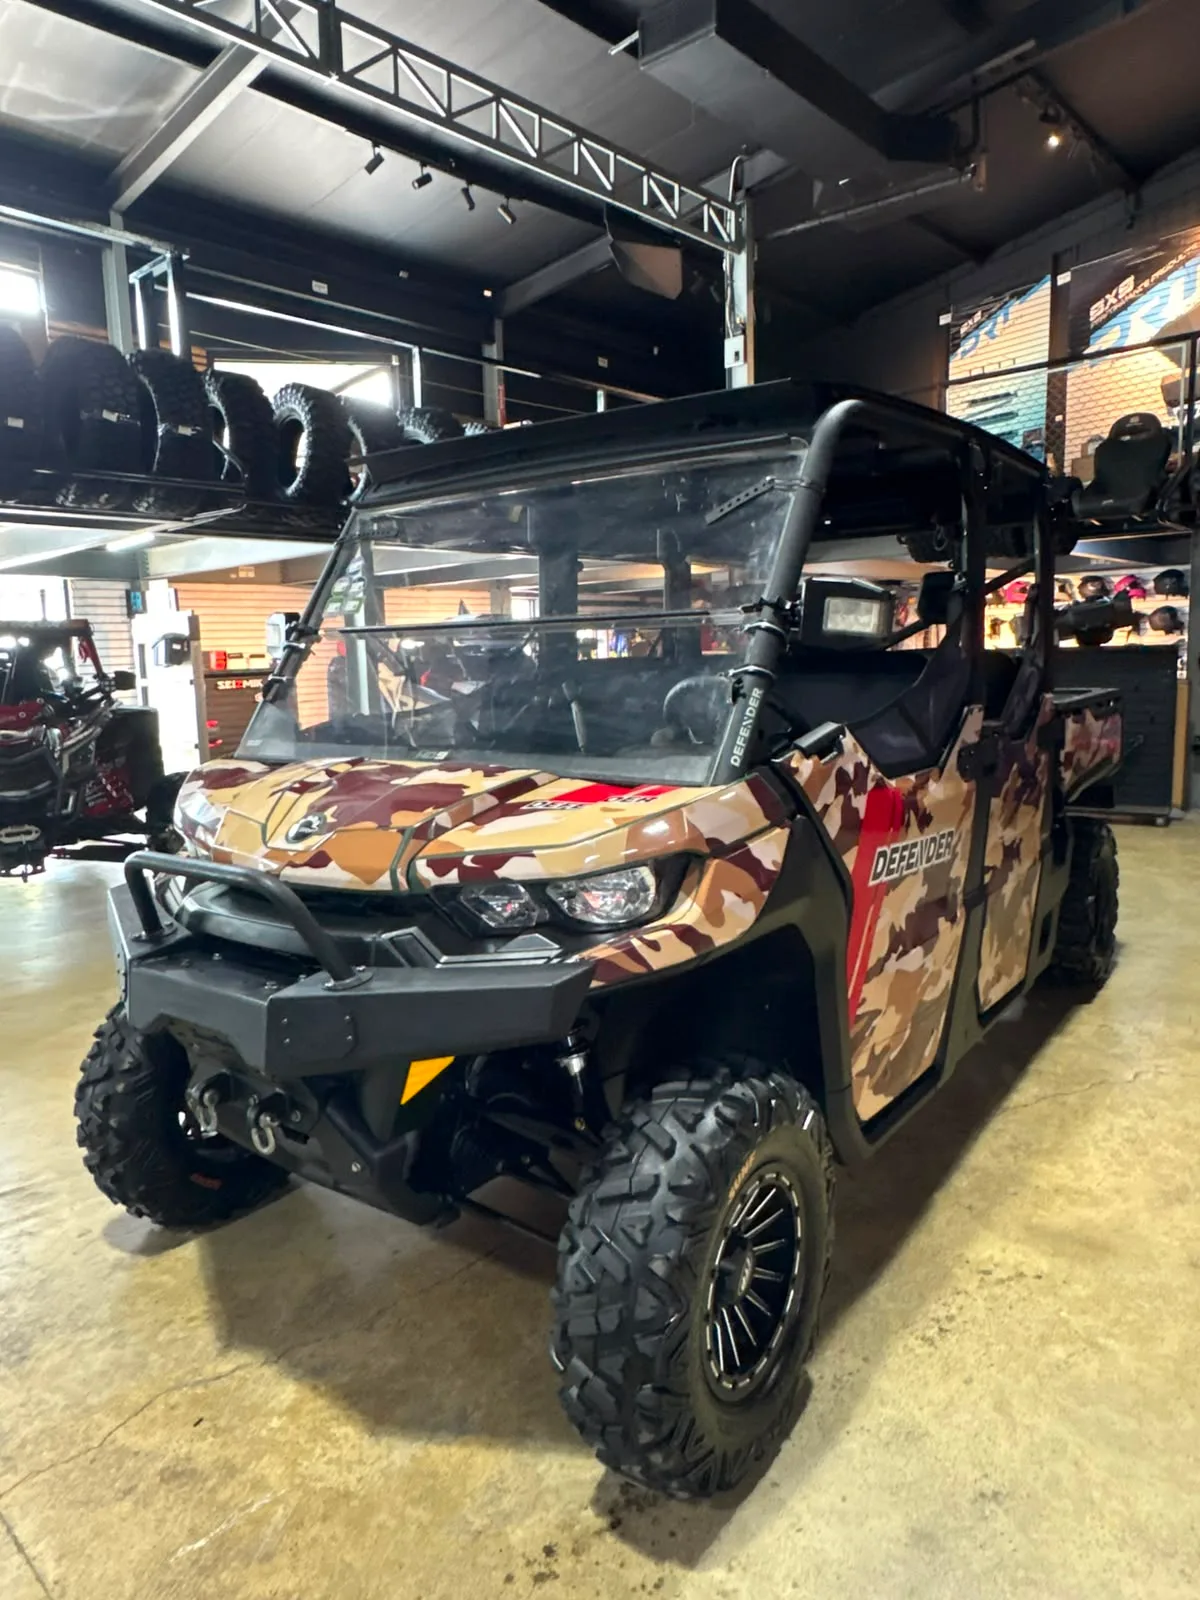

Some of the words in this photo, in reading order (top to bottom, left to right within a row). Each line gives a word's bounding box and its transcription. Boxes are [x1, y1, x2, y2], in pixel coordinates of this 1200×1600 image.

[730, 687, 764, 767] DEFENDER
[523, 796, 657, 809] DEFEDER
[869, 829, 955, 885] DEFENDER
